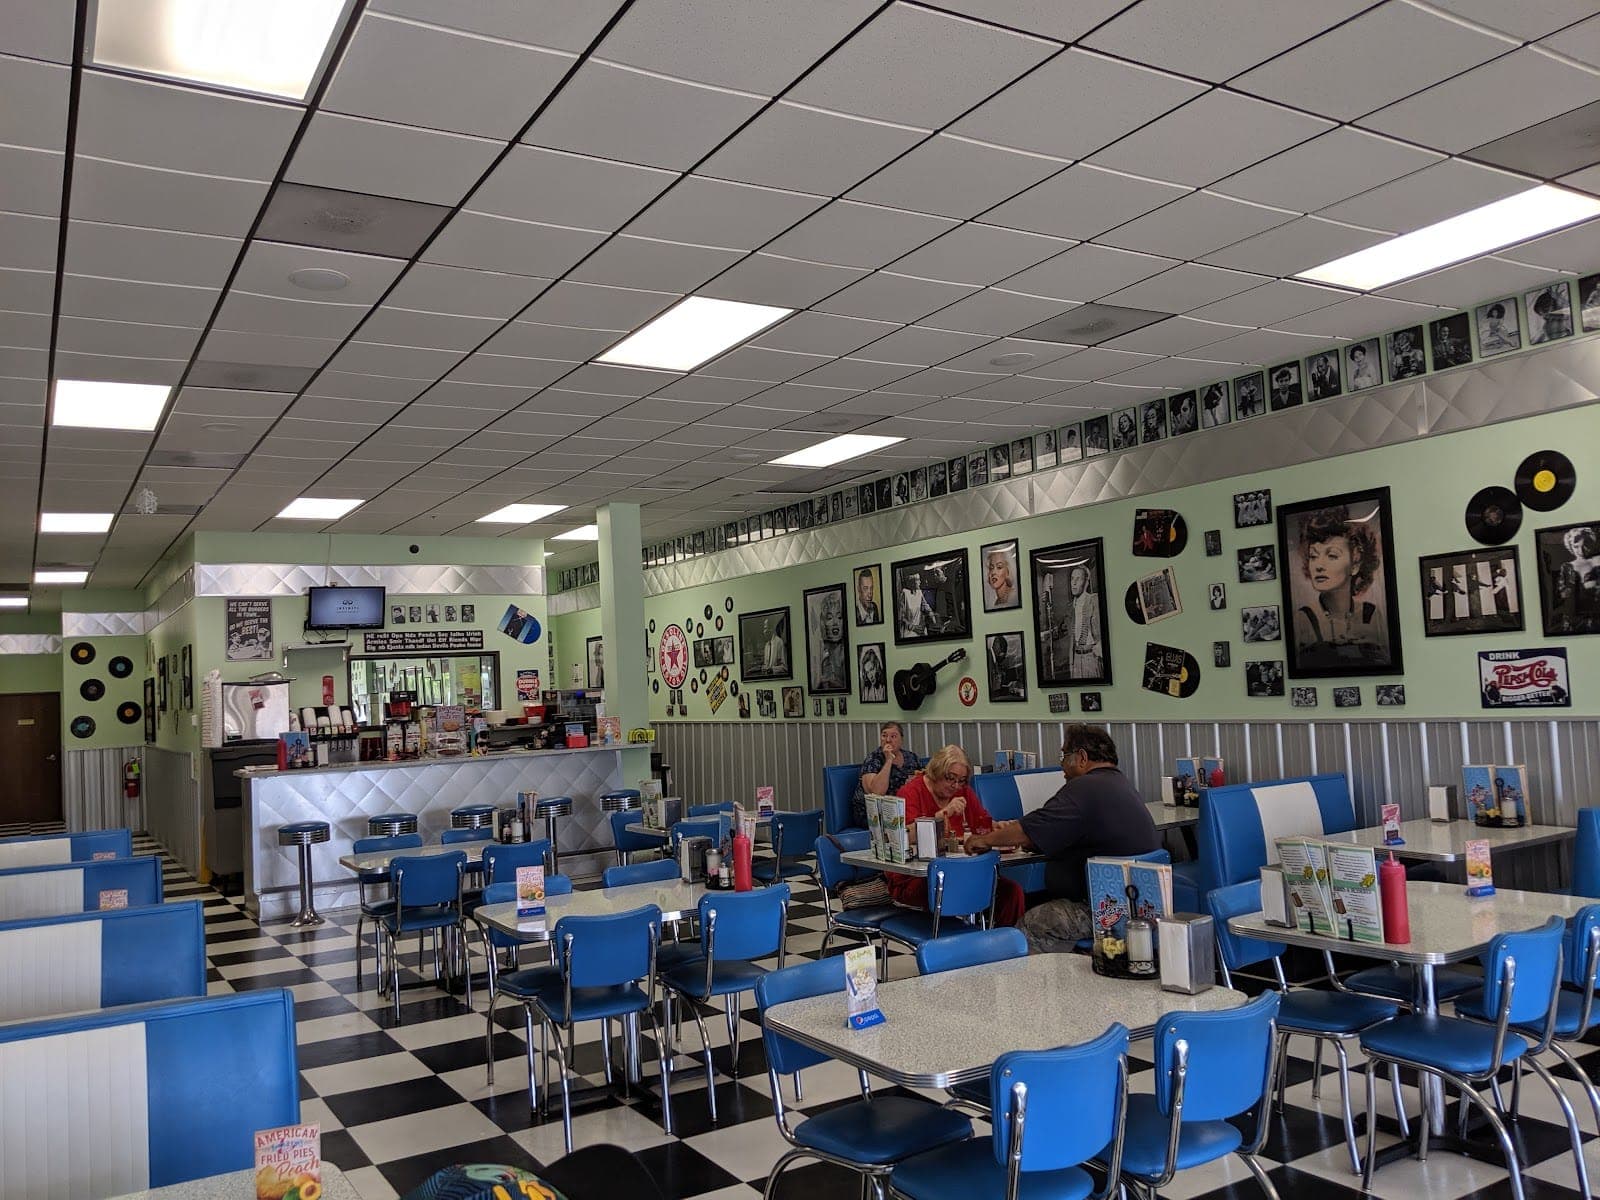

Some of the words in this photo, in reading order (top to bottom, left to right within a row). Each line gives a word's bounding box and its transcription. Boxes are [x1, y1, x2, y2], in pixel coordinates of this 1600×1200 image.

[1488, 652, 1520, 660] DRINK
[257, 1128, 318, 1148] AMERICAN
[260, 1150, 289, 1165] FRIED
[294, 1148, 314, 1159] PIES
[275, 1156, 320, 1181] Peach
